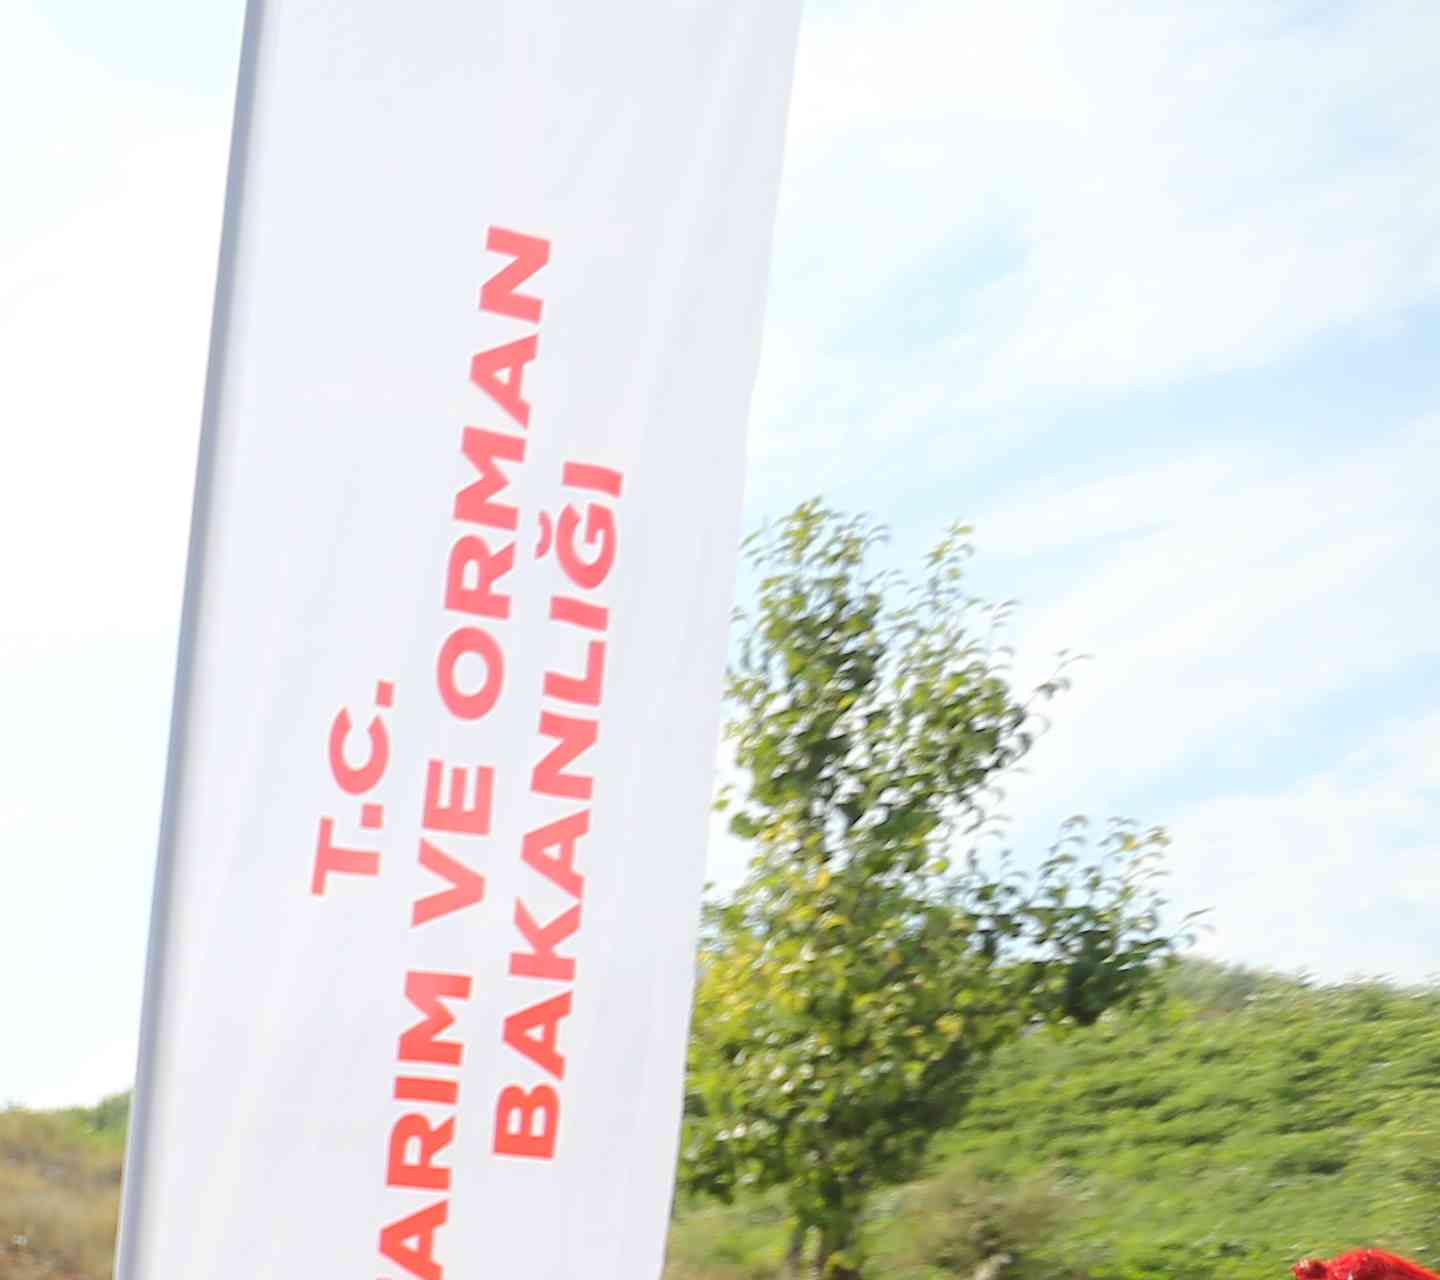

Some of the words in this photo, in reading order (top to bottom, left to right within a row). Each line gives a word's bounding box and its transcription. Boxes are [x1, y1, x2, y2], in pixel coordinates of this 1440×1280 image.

[436, 225, 552, 722] ORMAN
[310, 679, 395, 897] T.C.
[412, 758, 495, 927] VE
[492, 460, 625, 1162] BAKANLIĞI
